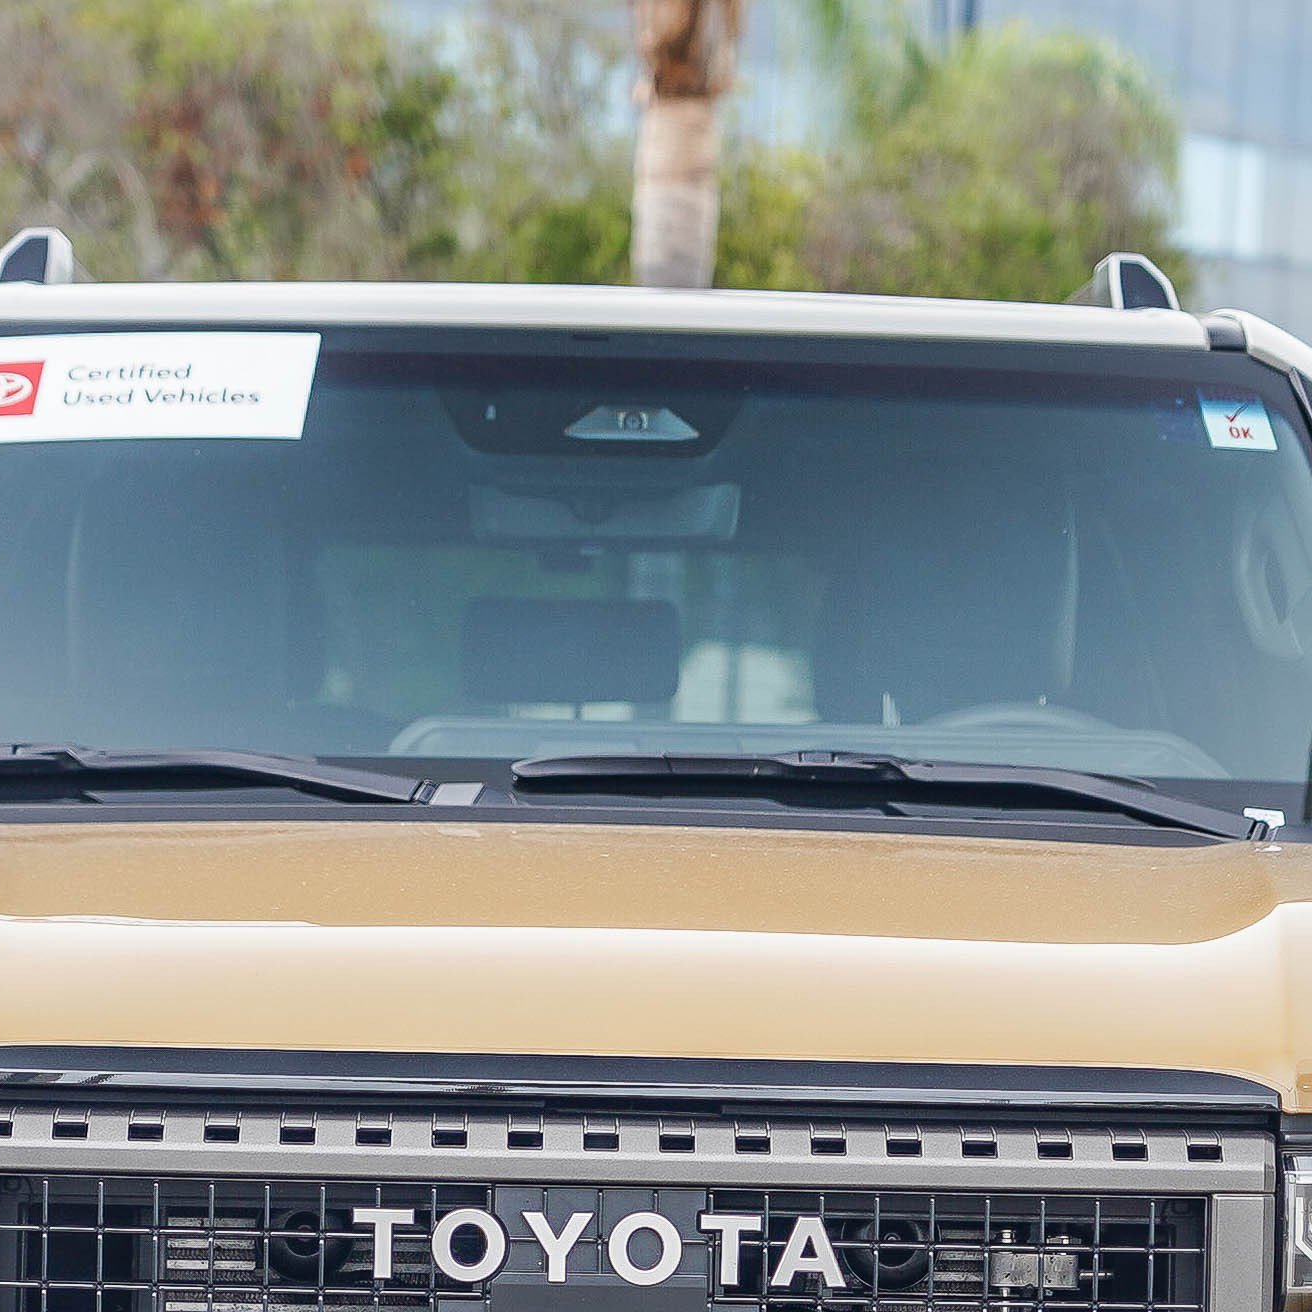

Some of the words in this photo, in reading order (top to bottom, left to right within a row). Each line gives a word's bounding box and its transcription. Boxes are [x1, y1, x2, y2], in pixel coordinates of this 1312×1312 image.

[67, 362, 192, 381] Certified
[63, 388, 134, 405] Used
[144, 387, 260, 404] Vehicles
[1229, 426, 1254, 439] OK
[351, 1207, 847, 1287] TOYOTA
